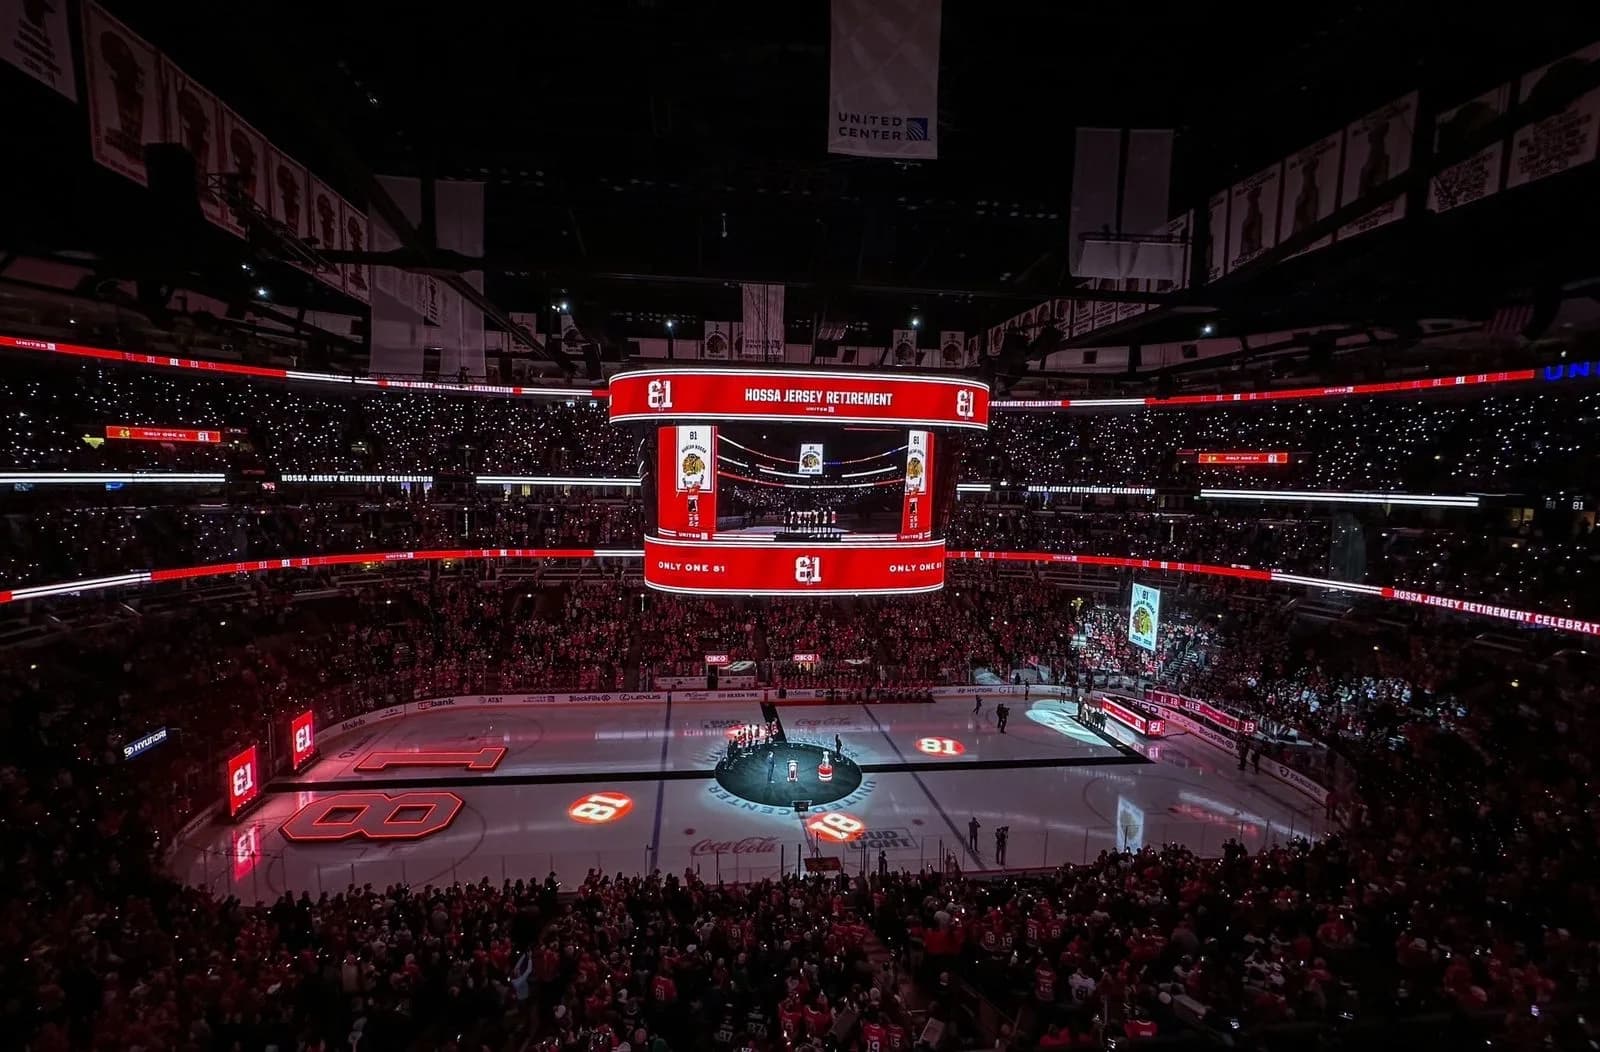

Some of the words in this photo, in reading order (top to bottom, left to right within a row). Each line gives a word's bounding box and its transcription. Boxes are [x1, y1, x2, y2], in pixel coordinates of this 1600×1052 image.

[838, 111, 903, 127] UNITED
[838, 126, 902, 141] CENTER
[1544, 361, 1600, 383] UN
[648, 380, 673, 409] 81
[745, 388, 781, 402] HOSSA
[783, 388, 823, 404] JERSEY
[826, 391, 893, 407] RETIREMENT
[956, 389, 975, 417] 81
[281, 474, 307, 482] HOSSA
[309, 474, 338, 482] JERSEY
[339, 474, 385, 482] RETIREMENT
[386, 475, 434, 483] CELEBRATION
[1111, 487, 1156, 495] CELEBRATION
[1572, 501, 1584, 511] 81
[658, 560, 681, 571] ONLY
[685, 562, 709, 573] ONE
[713, 564, 725, 573] 81
[795, 556, 822, 583] 81
[889, 563, 916, 573] ONLY
[919, 562, 936, 571] ONE
[1393, 589, 1422, 603] HOSSA
[1424, 595, 1461, 609] JERSEY
[1463, 602, 1532, 622] RETIREMENT
[134, 729, 168, 752] HYUNDAI
[296, 723, 311, 754] 81
[919, 737, 958, 755] 81
[233, 762, 254, 797] 81
[571, 794, 630, 821] 81
